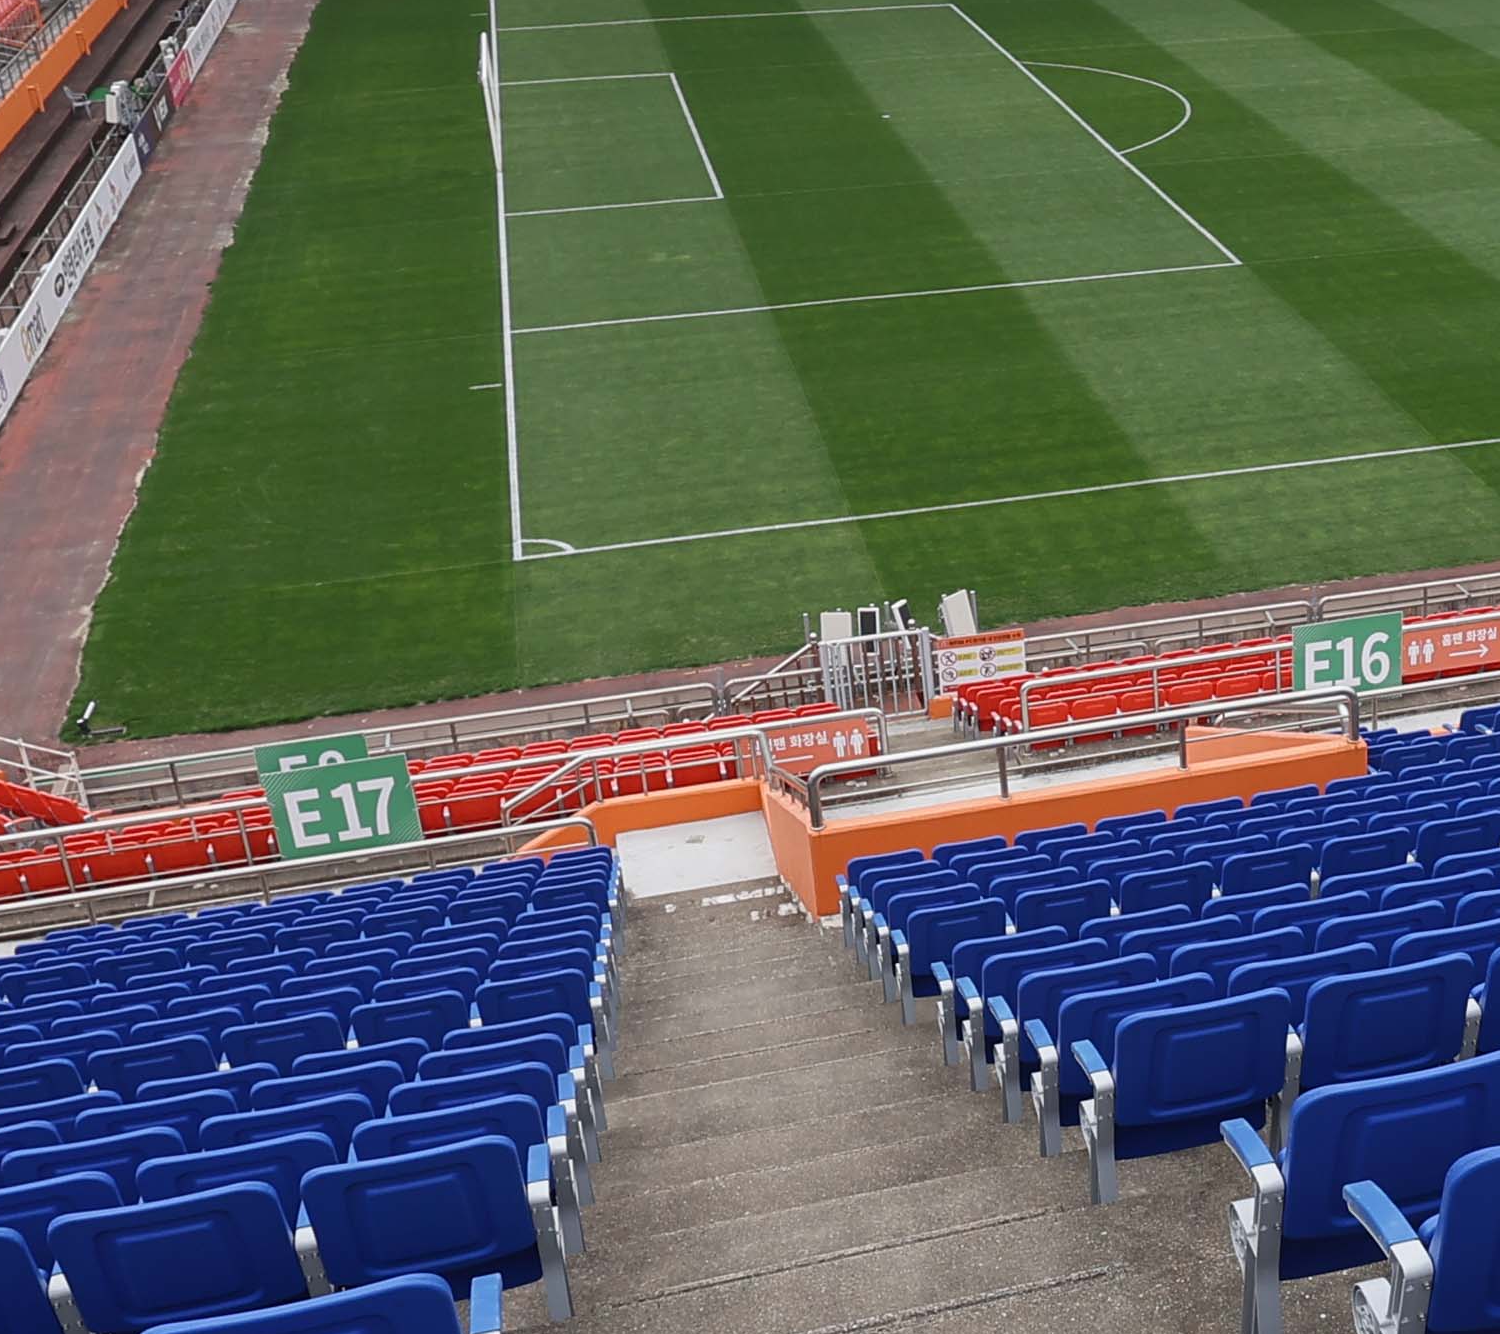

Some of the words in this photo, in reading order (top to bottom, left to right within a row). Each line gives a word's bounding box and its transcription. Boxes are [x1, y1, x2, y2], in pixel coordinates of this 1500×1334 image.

[1441, 631, 1463, 648] 홈팬
[1465, 626, 1498, 643] 화장실
[1304, 631, 1391, 689] E16
[789, 730, 829, 748] 화장실
[283, 776, 395, 849] E17
